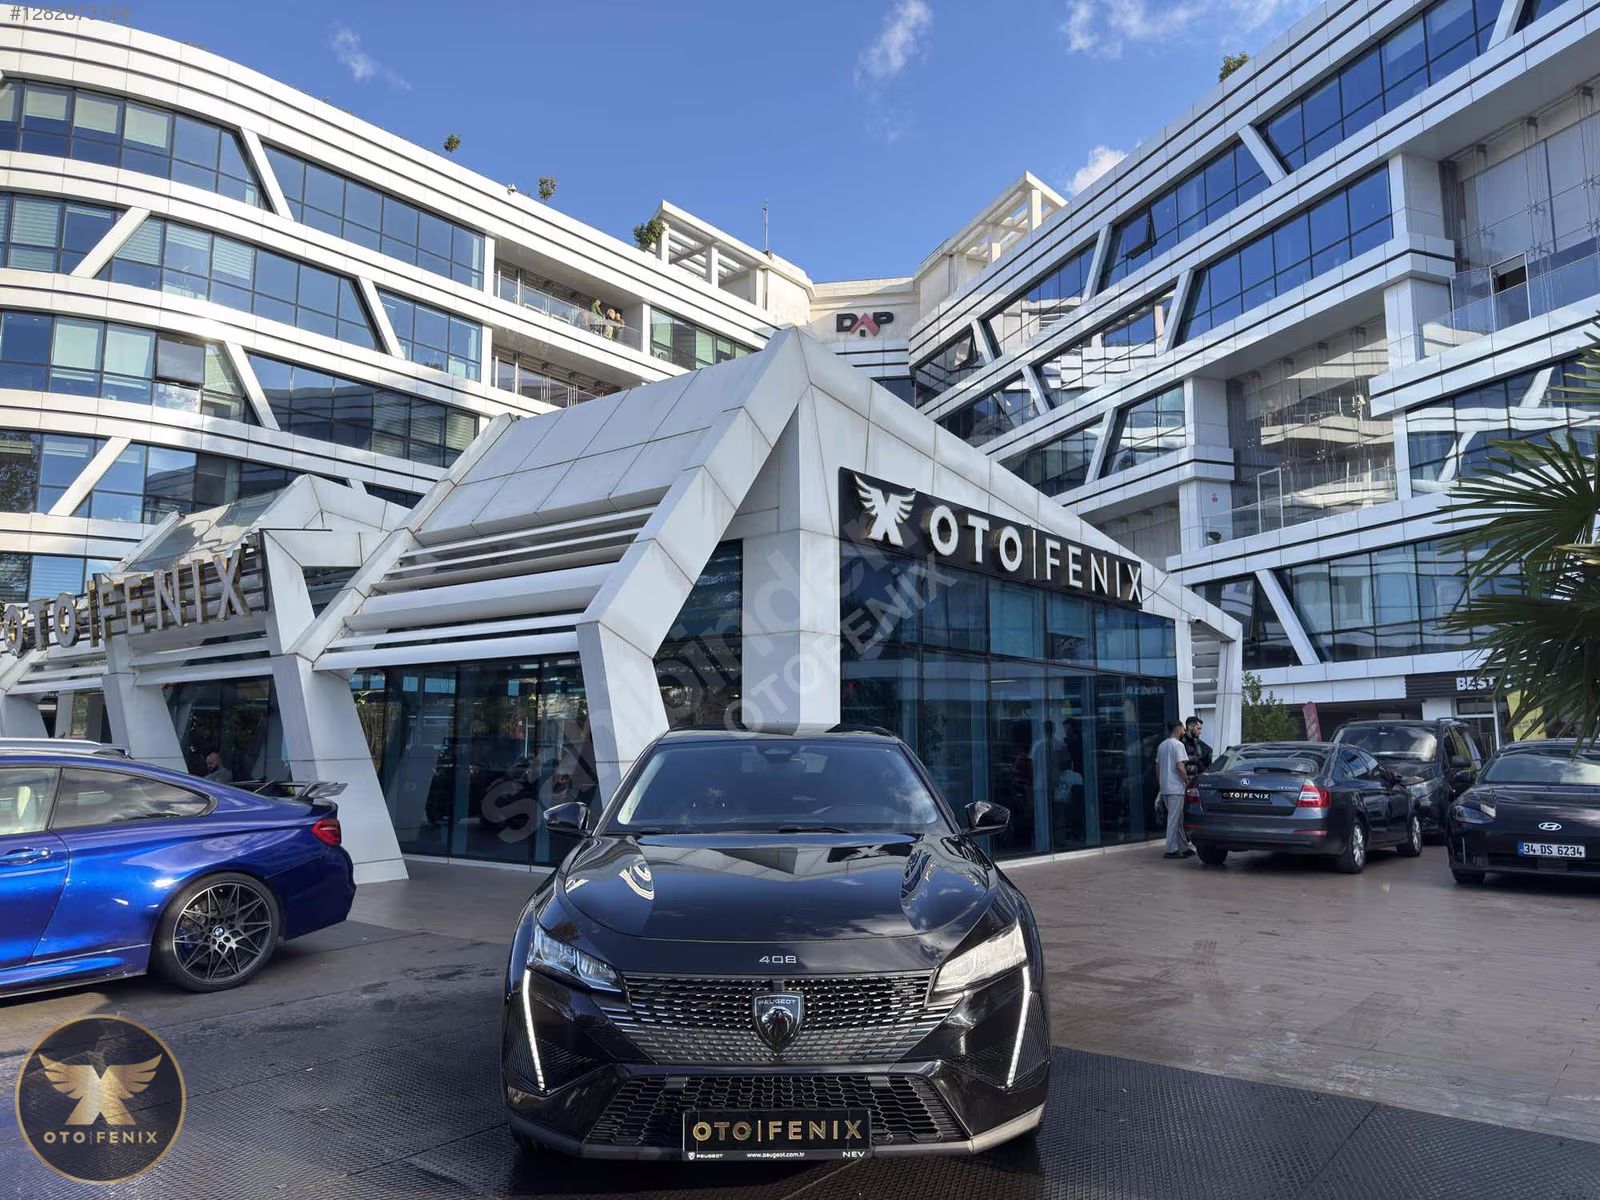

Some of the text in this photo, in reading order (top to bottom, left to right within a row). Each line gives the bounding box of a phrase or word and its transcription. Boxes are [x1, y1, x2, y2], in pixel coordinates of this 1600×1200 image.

[1456, 676, 1496, 691] BEST
[1524, 843, 1583, 857] 34 DS 6234
[759, 955, 797, 964] 408
